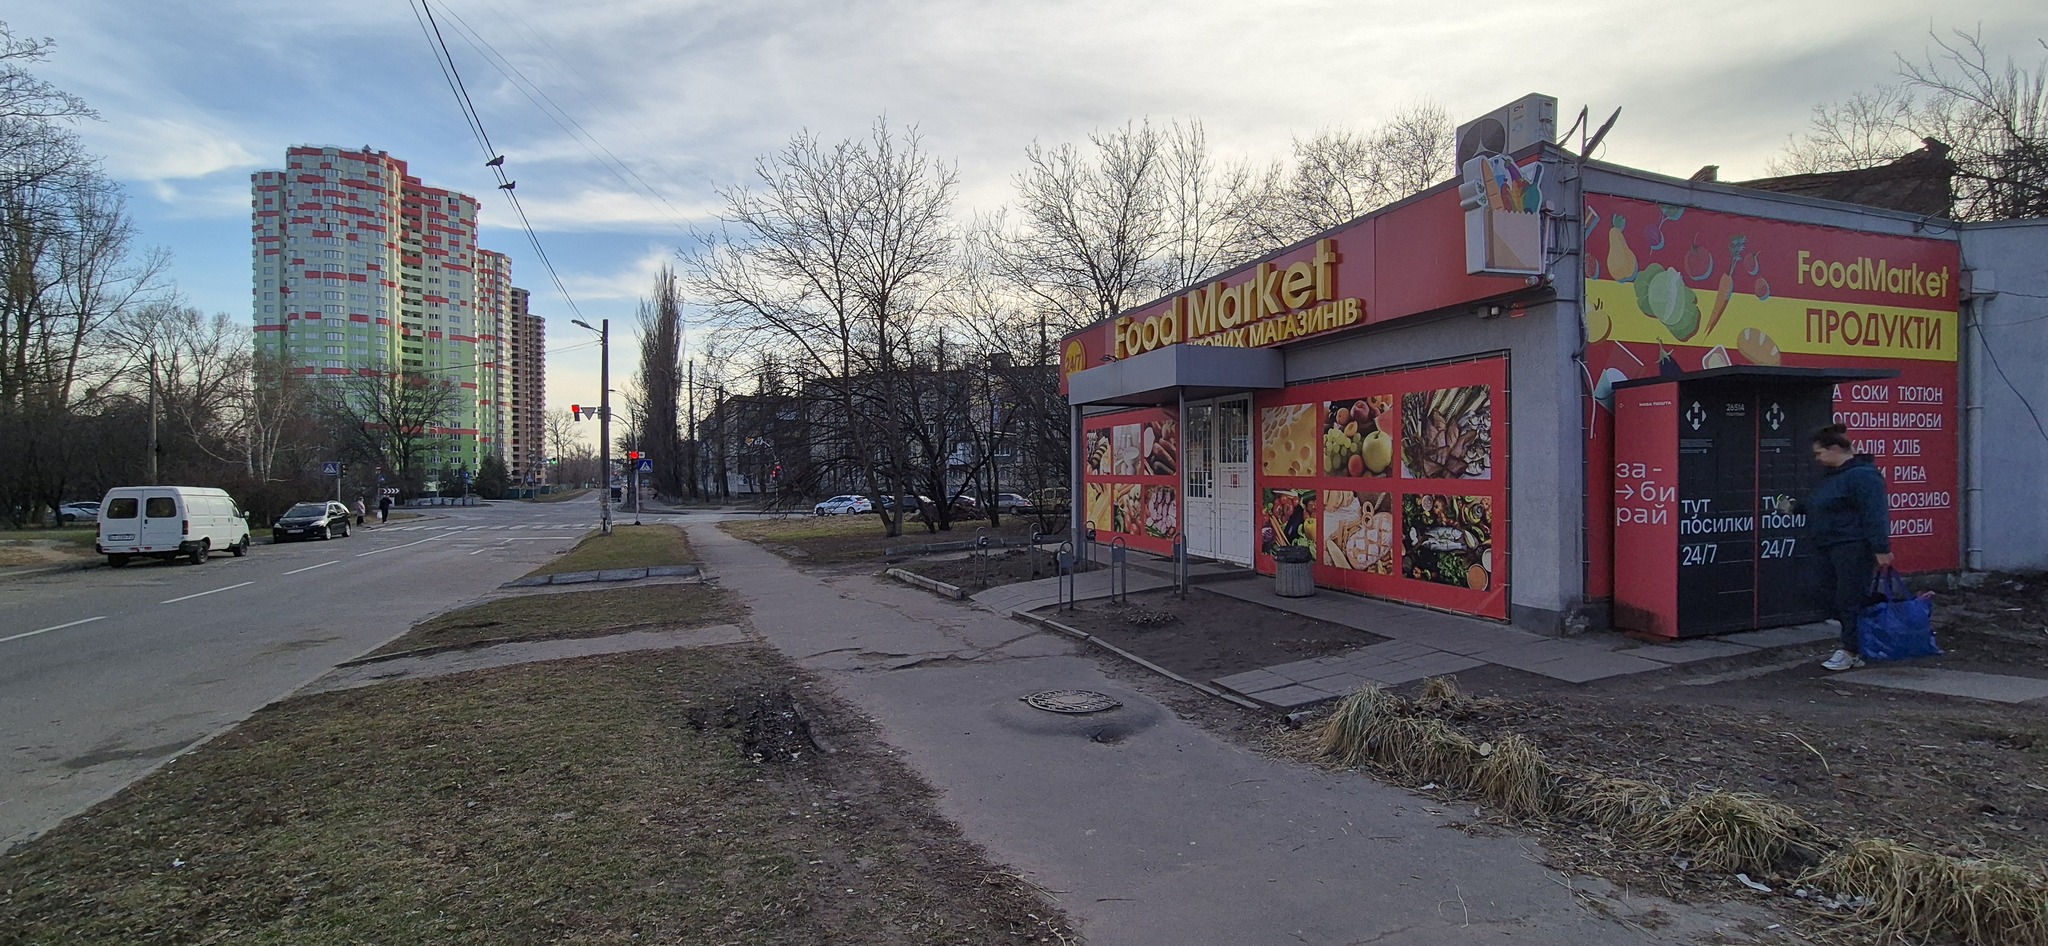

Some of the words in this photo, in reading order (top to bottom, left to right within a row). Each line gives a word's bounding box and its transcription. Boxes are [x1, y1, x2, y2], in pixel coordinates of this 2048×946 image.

[1797, 249, 1949, 298] FoodMarket
[1114, 295, 1184, 360] Food
[1188, 239, 1336, 338] Market
[1250, 299, 1360, 348] МАГАЗИНІВ
[1806, 308, 1941, 351] ПРОДУКТИ
[1852, 385, 1889, 400] СОКИ
[1898, 386, 1943, 402] ТЮТЮН
[1726, 403, 1745, 411] 26514
[1892, 412, 1942, 428] ВИРОБИ
[1893, 439, 1920, 454] ХЛІБ
[1894, 465, 1927, 481] РИБА
[1640, 480, 1675, 503] би
[1887, 491, 1950, 508] ОРОЗИВО
[1616, 503, 1668, 527] рай
[1680, 516, 1754, 536] ПОСИЛКИ
[1890, 518, 1933, 535] ИРОБИ
[1682, 543, 1717, 566] 24/7
[1761, 538, 1796, 559] 24/7
